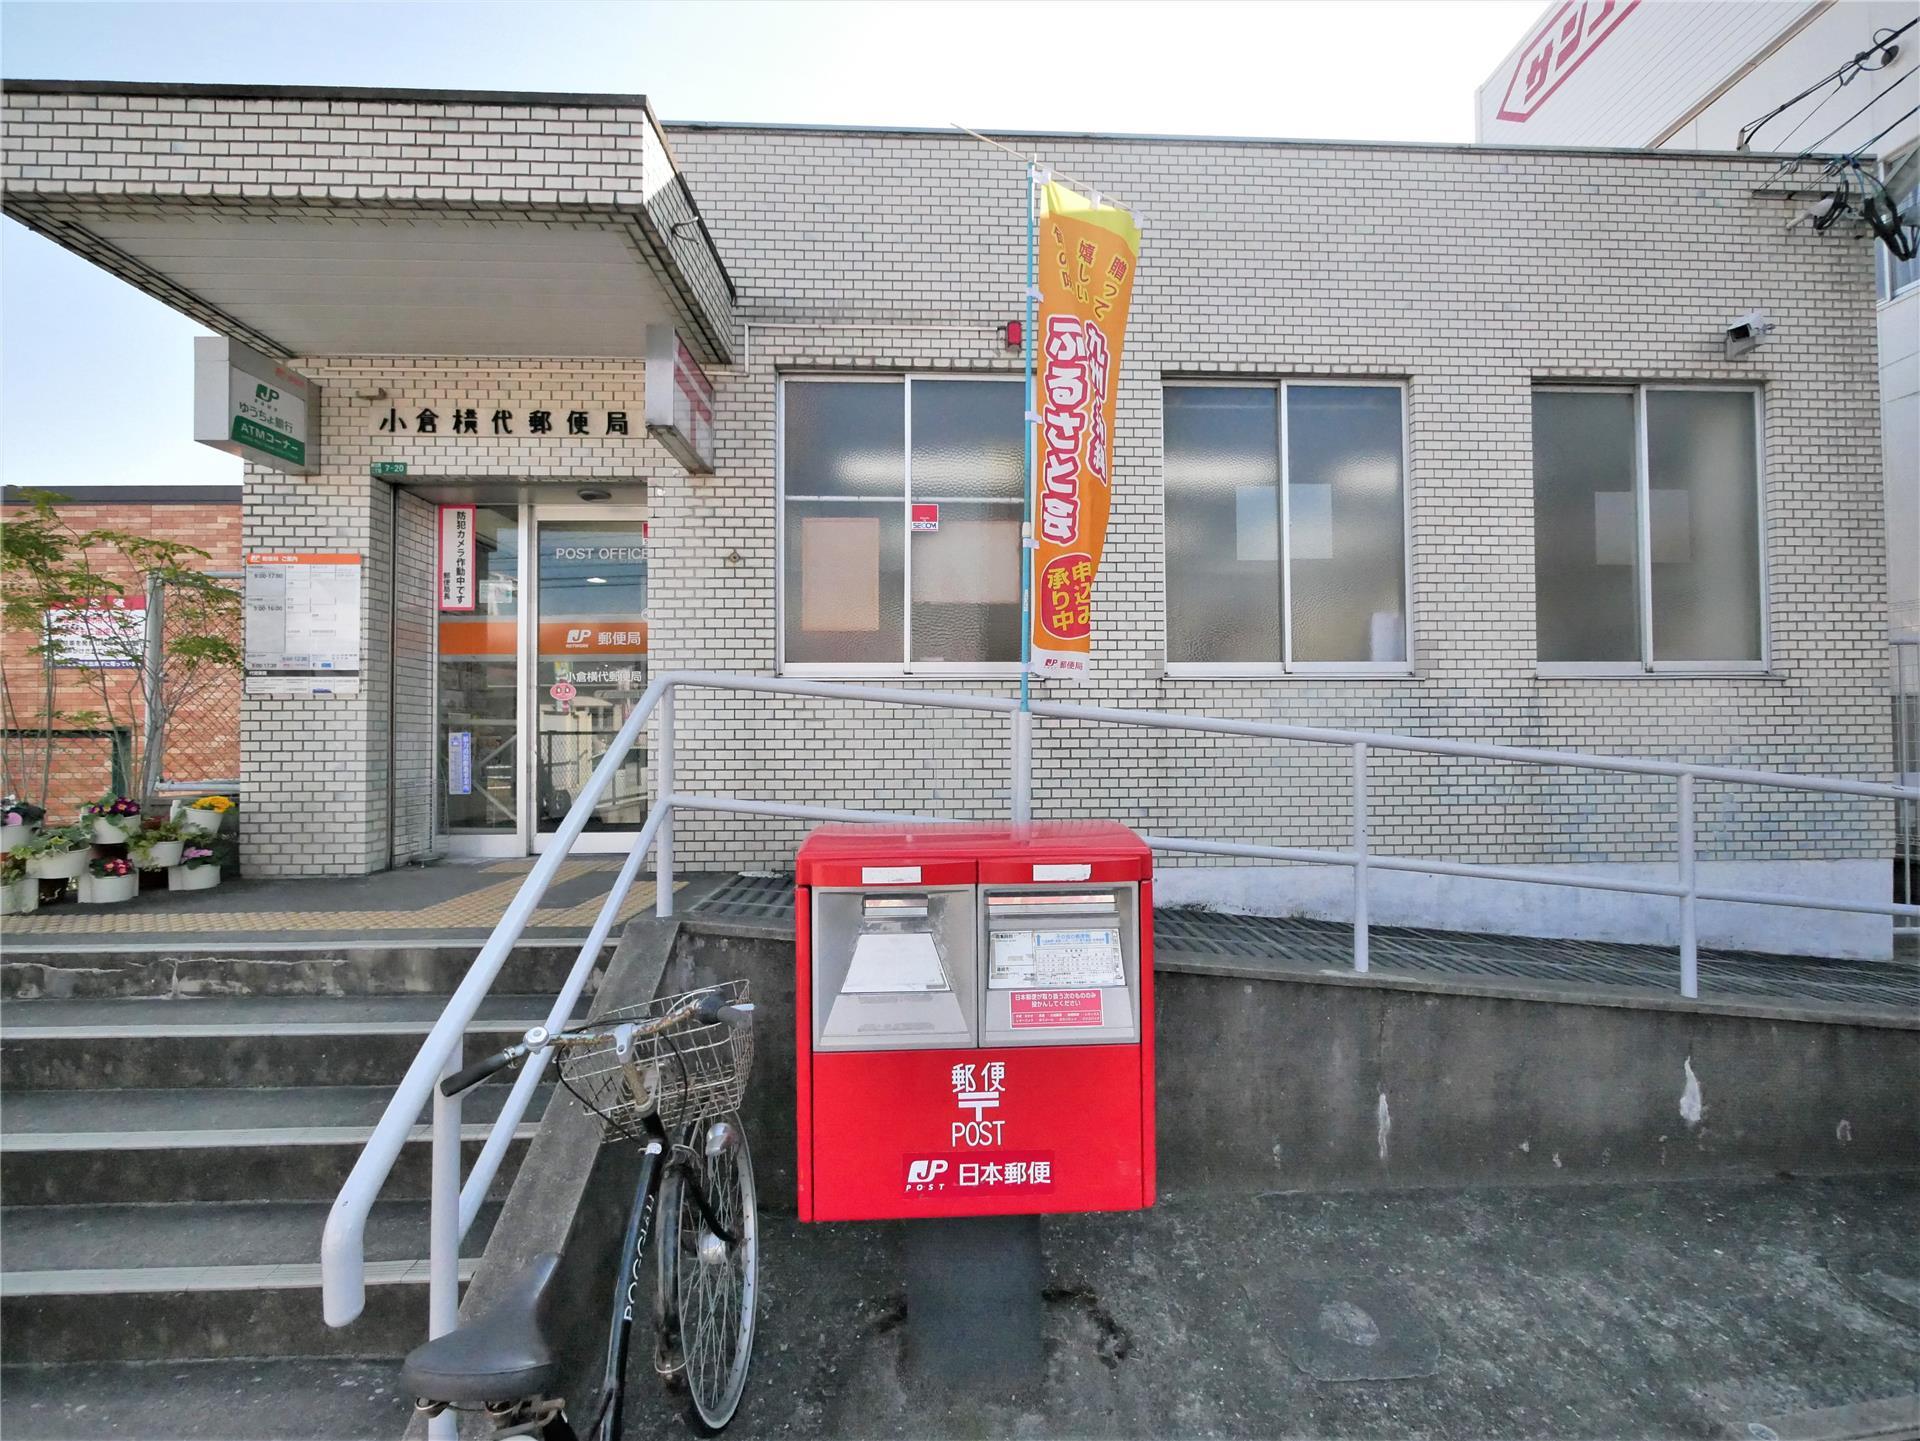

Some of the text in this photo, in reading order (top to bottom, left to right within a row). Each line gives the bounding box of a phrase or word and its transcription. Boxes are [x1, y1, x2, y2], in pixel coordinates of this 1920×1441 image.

[239, 401, 293, 433] ゆうちょ銀行
[379, 407, 629, 436] 小倉横代郵便局
[241, 423, 298, 451] ATMコーナー
[385, 464, 405, 473] 7-20
[456, 511, 466, 604] 防犯カメラ作動中です
[556, 547, 648, 560] POST OFFICE
[1047, 567, 1075, 632] 承り中
[597, 631, 641, 646] 郵便局
[951, 1061, 1006, 1093] 郵便
[951, 1120, 1006, 1148] POST
[906, 1183, 944, 1192] POST
[959, 1161, 1051, 1187] 日本郵便
